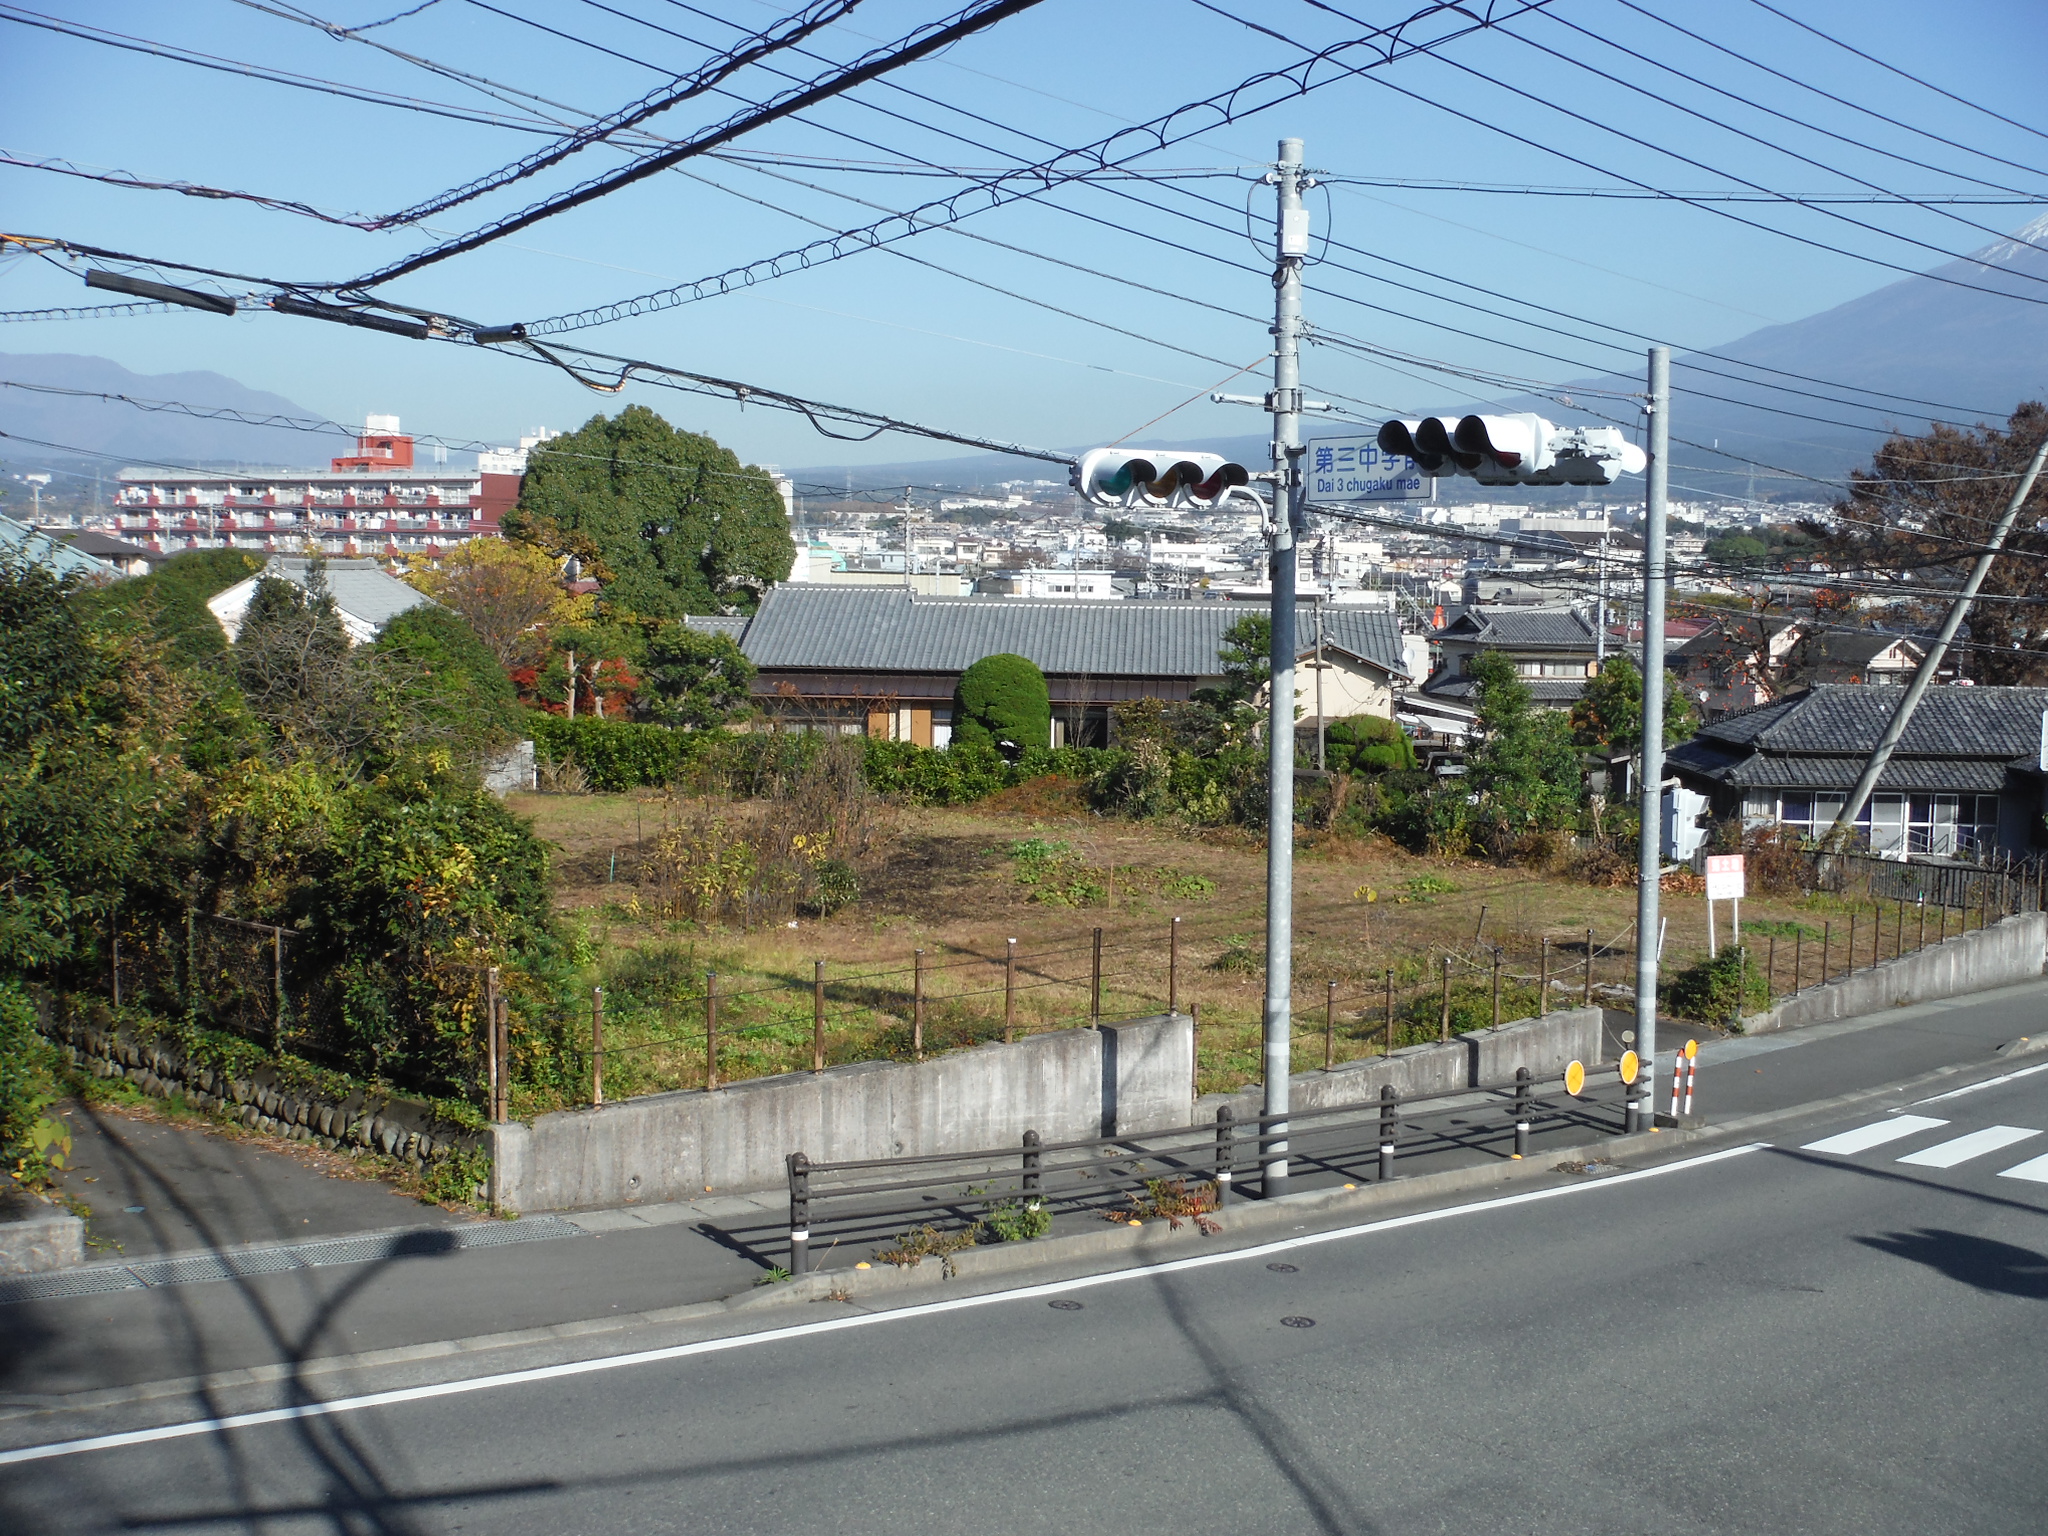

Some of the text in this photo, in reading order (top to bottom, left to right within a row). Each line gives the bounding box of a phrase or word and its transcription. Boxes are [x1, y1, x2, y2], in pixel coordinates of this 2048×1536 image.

[1317, 477, 1420, 494] Dai 3 chugaku mae
